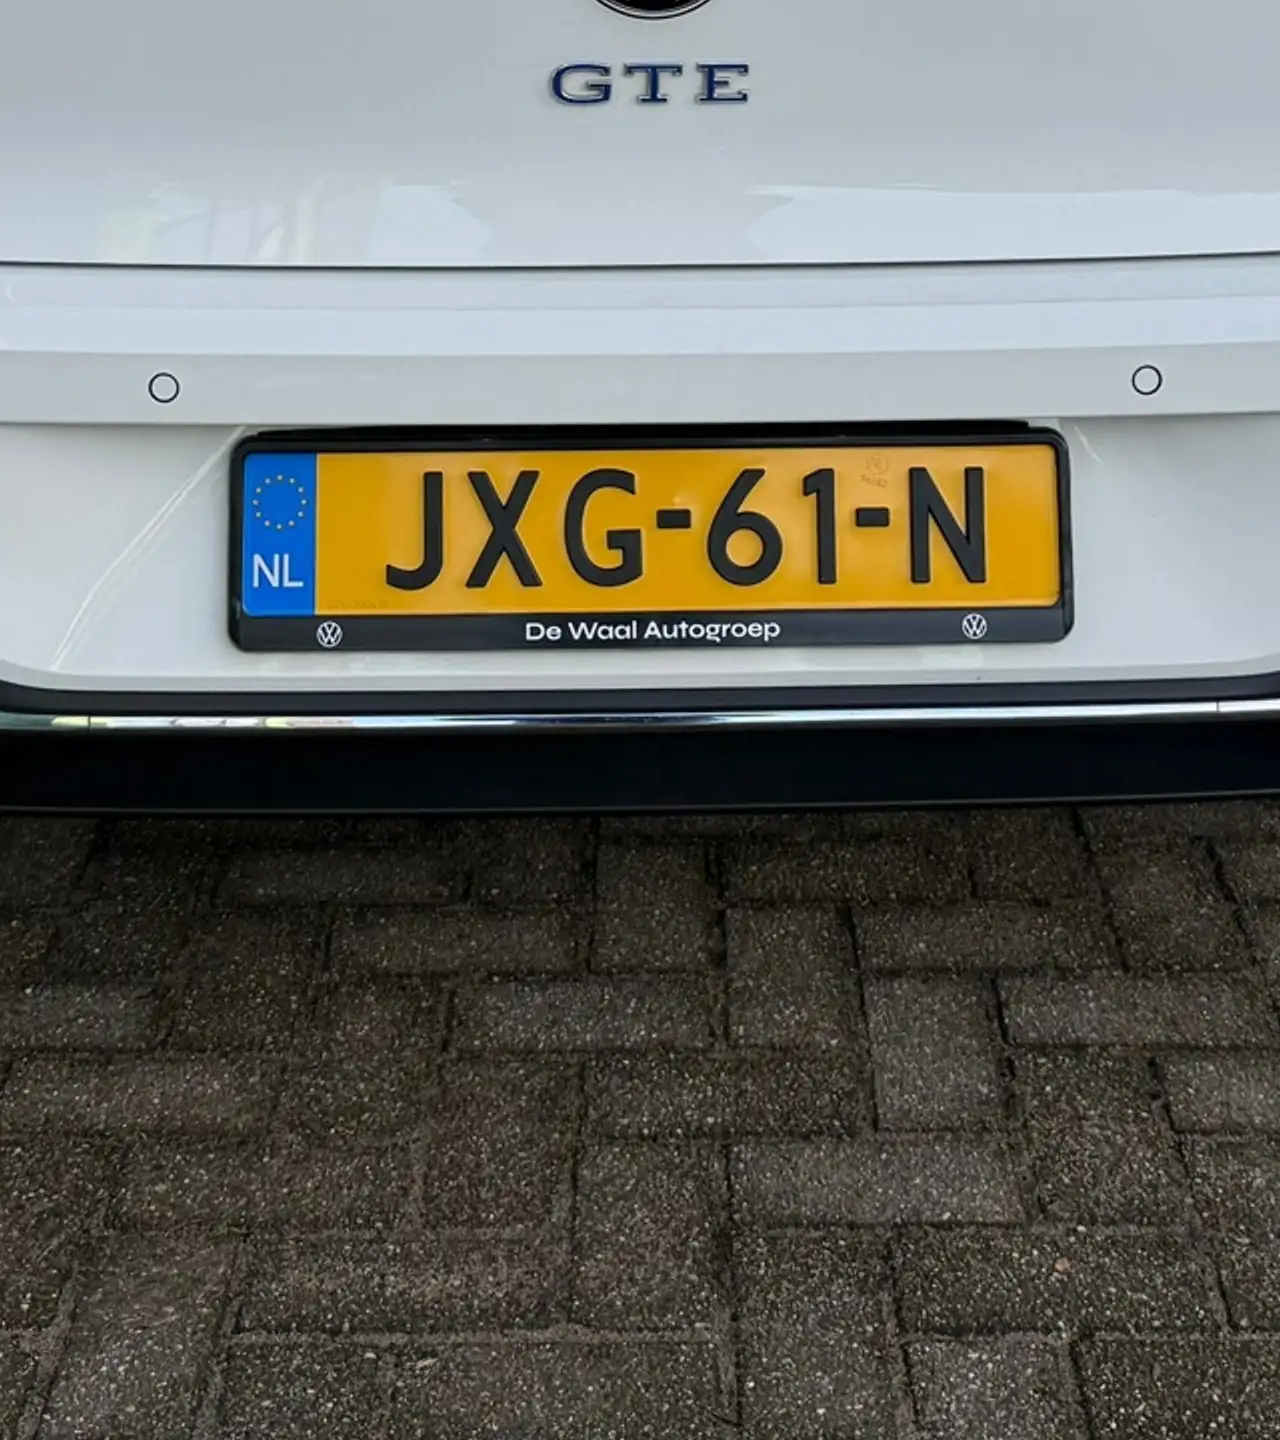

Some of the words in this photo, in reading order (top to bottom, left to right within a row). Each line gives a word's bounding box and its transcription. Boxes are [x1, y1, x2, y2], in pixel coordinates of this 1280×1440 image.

[549, 63, 751, 105] GTE
[386, 466, 989, 590] JXG-61-N
[252, 552, 305, 588] NL
[524, 622, 562, 641] De
[568, 620, 638, 641] Waal
[643, 620, 782, 643] Autogroep
